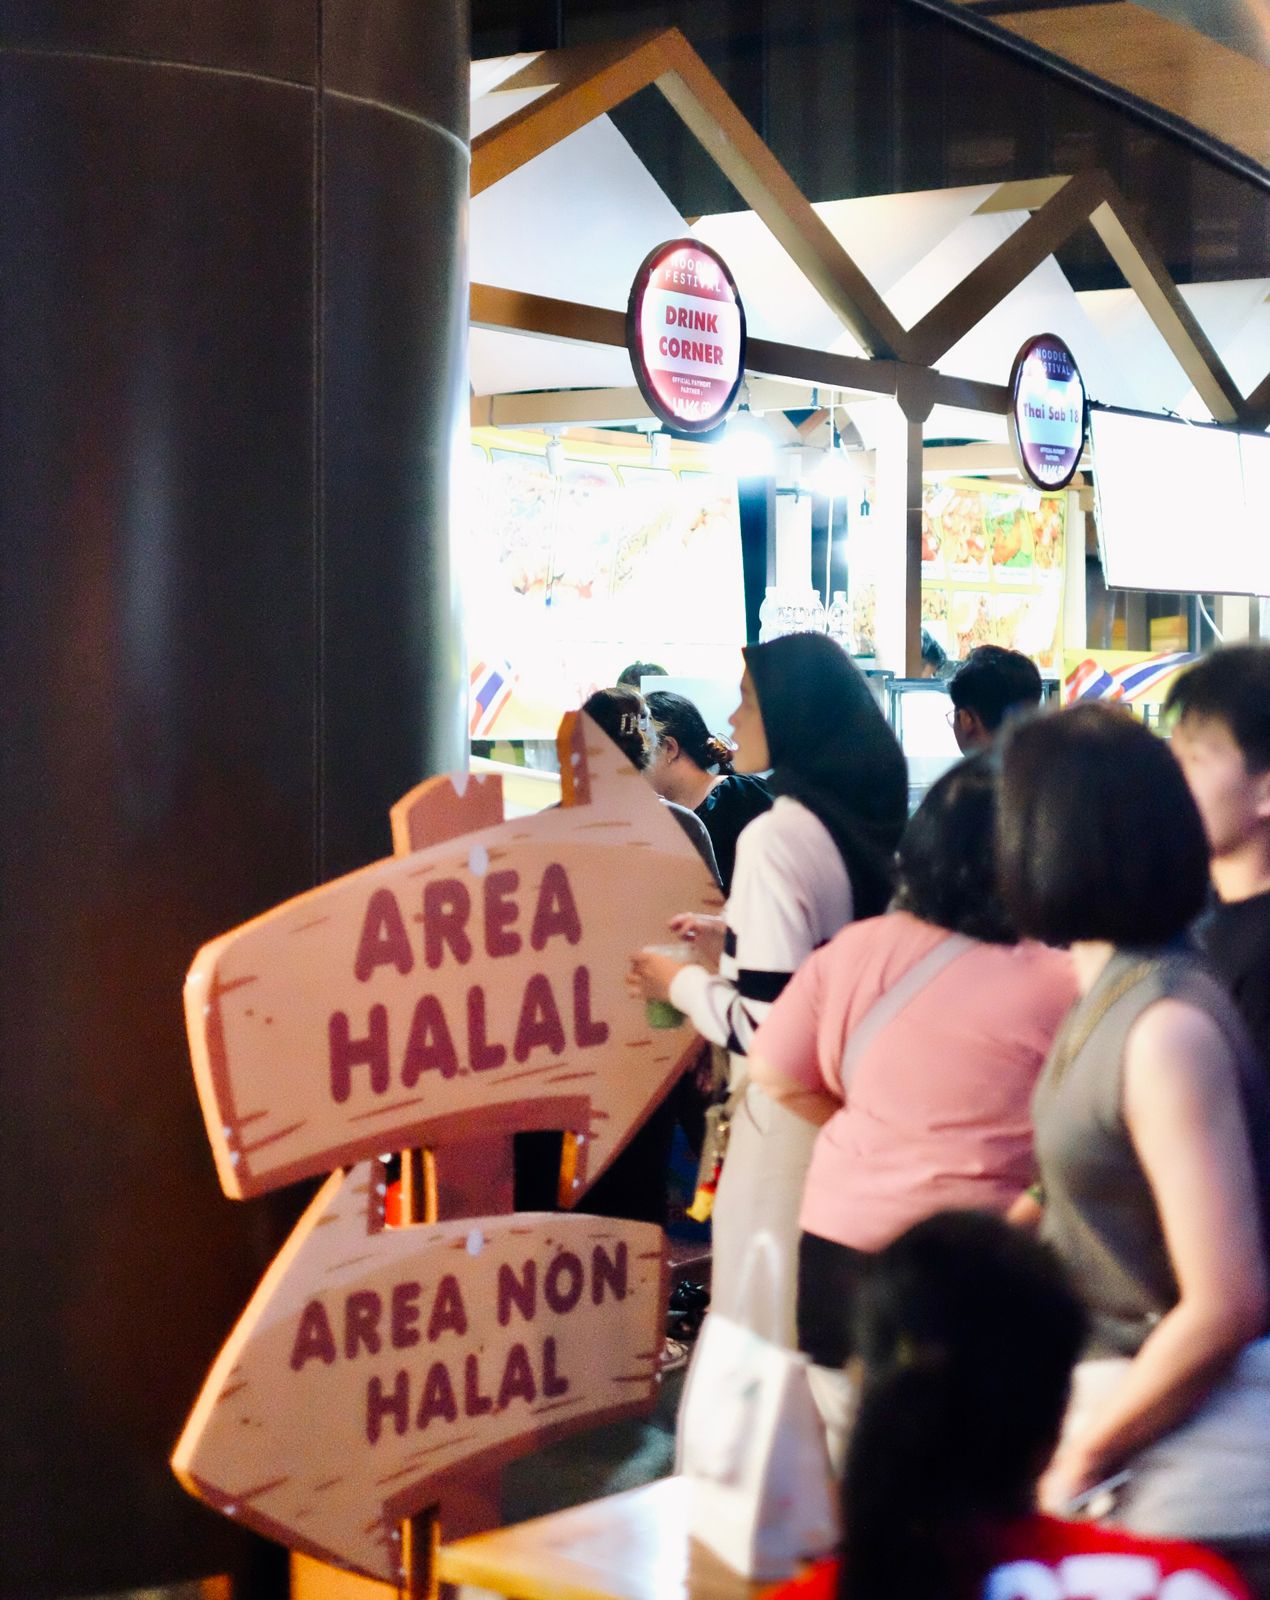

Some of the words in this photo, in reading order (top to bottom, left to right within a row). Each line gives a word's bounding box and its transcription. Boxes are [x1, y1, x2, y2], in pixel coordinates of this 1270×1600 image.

[658, 335, 724, 365] CORNER
[665, 305, 719, 334] DRINK
[1023, 402, 1045, 419] Thai
[1048, 405, 1066, 421] Sab
[1069, 408, 1080, 424] 18
[354, 861, 583, 983] AREA
[328, 964, 610, 1104] HALAL
[290, 1273, 469, 1372] AREA
[498, 1241, 629, 1326] NON
[366, 1336, 570, 1446] HALAL
